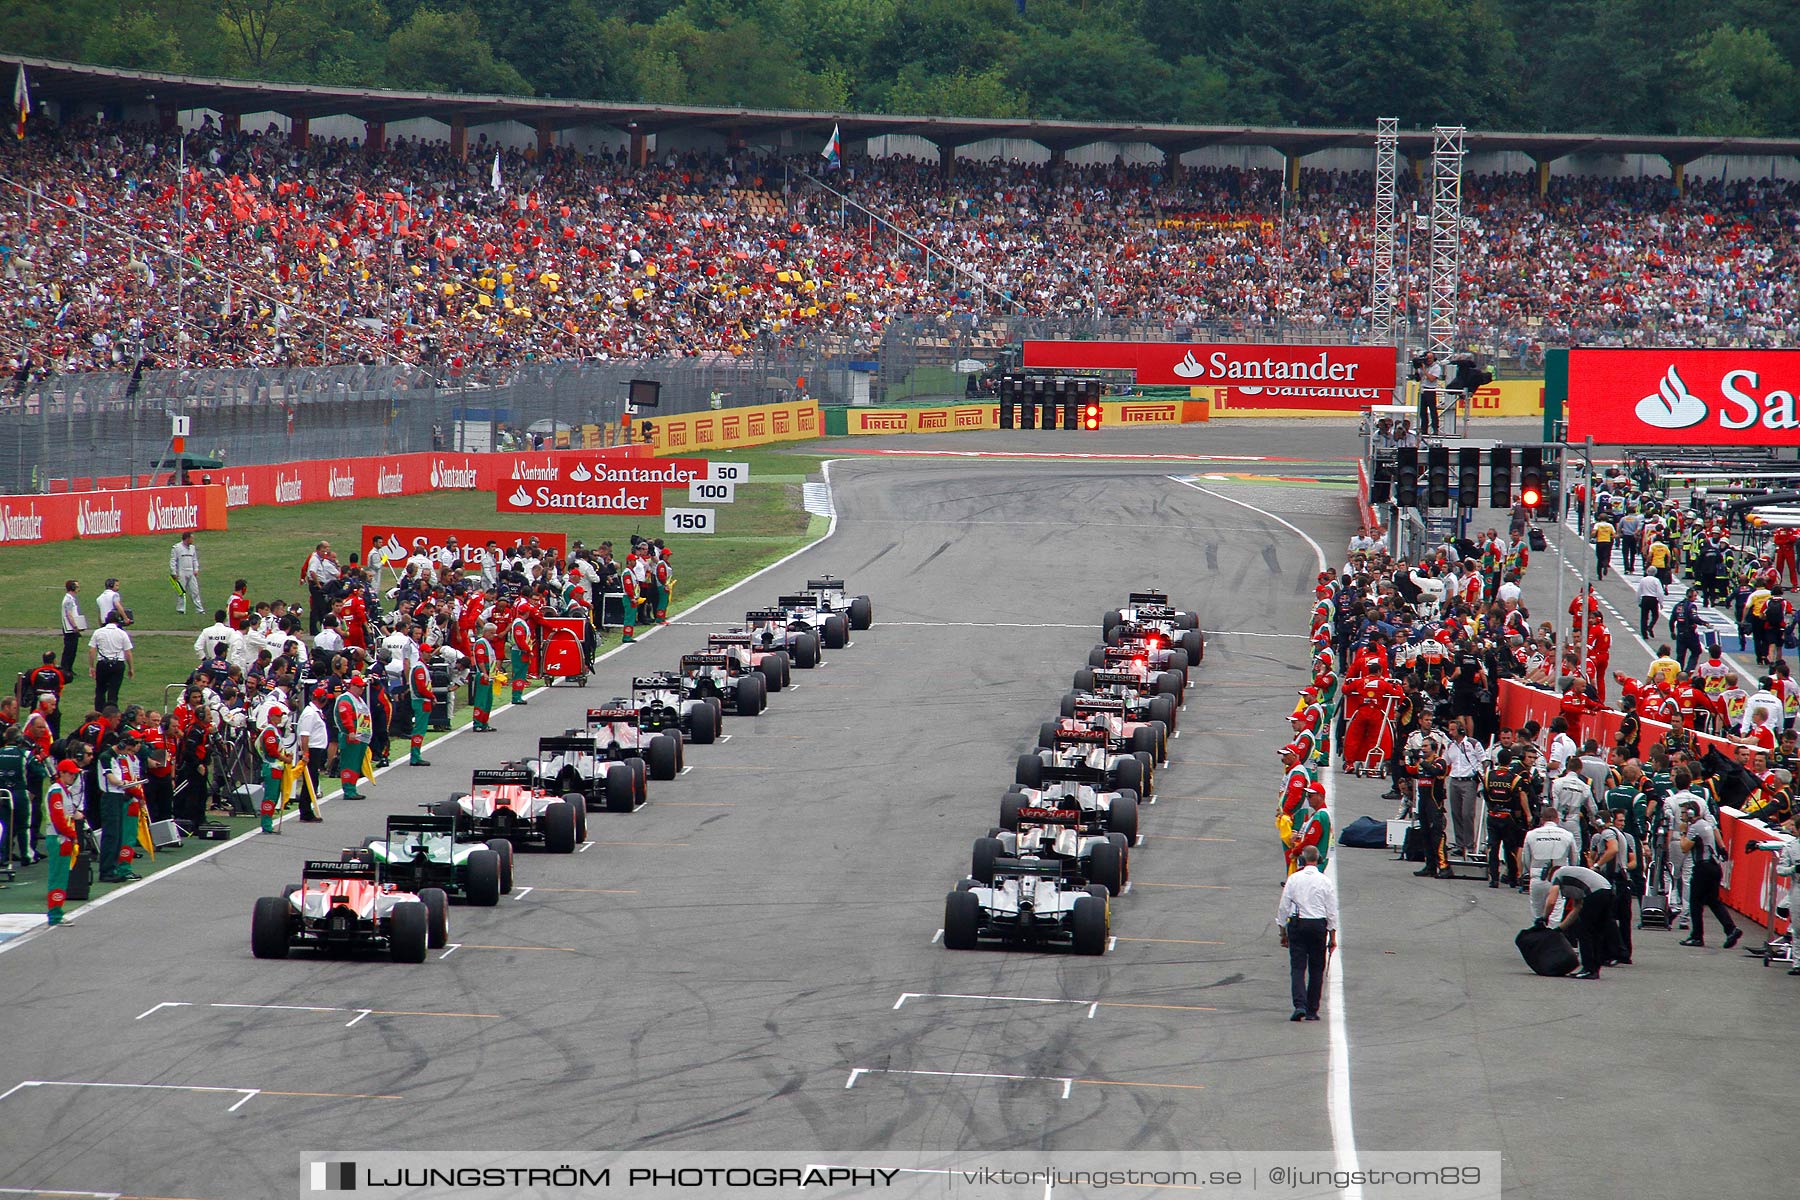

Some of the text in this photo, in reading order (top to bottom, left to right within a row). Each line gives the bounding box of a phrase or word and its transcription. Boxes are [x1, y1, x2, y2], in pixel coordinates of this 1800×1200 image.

[1210, 352, 1358, 382] Santander
[748, 412, 766, 437] PIRELLI
[772, 410, 790, 434] PIRELLI
[797, 407, 815, 431] PIRELLI
[861, 413, 907, 430] PIRELLI
[918, 411, 947, 428] PIRELLI
[954, 409, 983, 426] PIRELLI
[1121, 405, 1176, 422] PIRELLI
[178, 419, 183, 433] 1
[668, 422, 687, 447] PIRELLI
[695, 419, 714, 444] PIRELLI
[722, 415, 740, 440] PIRELLI
[439, 458, 477, 488] Santander
[520, 457, 559, 480] Santander
[594, 463, 698, 483] Santander
[718, 467, 738, 480] 50
[226, 472, 249, 507] Santander
[536, 486, 649, 510] Santander
[696, 485, 728, 498] 100
[5, 501, 43, 541] Santander
[85, 496, 122, 535] Santander
[156, 491, 198, 530] Santander
[672, 514, 707, 529] 150
[547, 663, 561, 671] 14
[635, 677, 668, 686] asos
[1056, 730, 1104, 738] Venezuela
[1020, 809, 1075, 819] Venezuela
